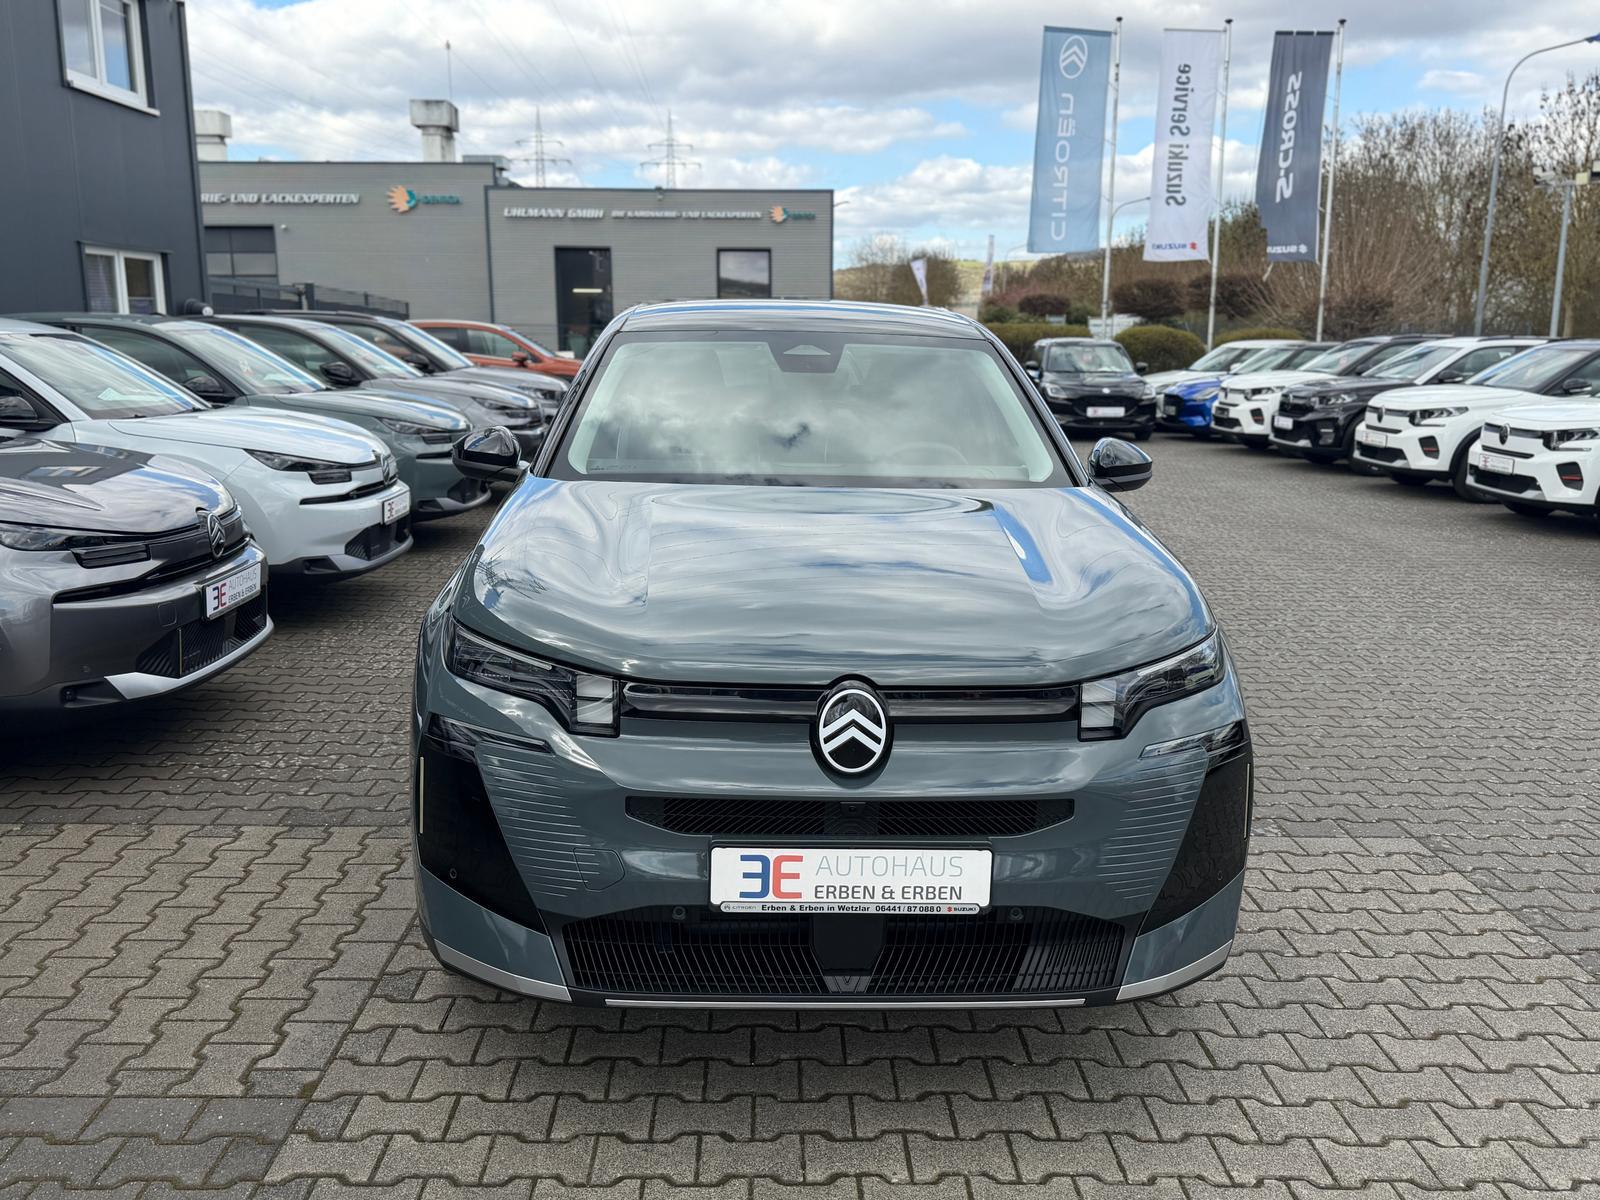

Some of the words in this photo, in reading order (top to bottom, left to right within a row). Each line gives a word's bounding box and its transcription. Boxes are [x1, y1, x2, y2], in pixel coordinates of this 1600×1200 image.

[230, 193, 258, 204] UND
[261, 193, 360, 205] LACKEXPERTEN
[503, 207, 565, 218] UHLMANN
[815, 855, 963, 877] AUTOHAUS
[814, 885, 876, 900] ERBEN
[881, 886, 896, 900] &
[901, 885, 963, 900] ERBEN
[761, 904, 787, 912] Erben
[789, 904, 796, 912] &
[799, 904, 825, 912] Erben
[827, 904, 835, 912] in
[838, 904, 870, 913] Wetzlar
